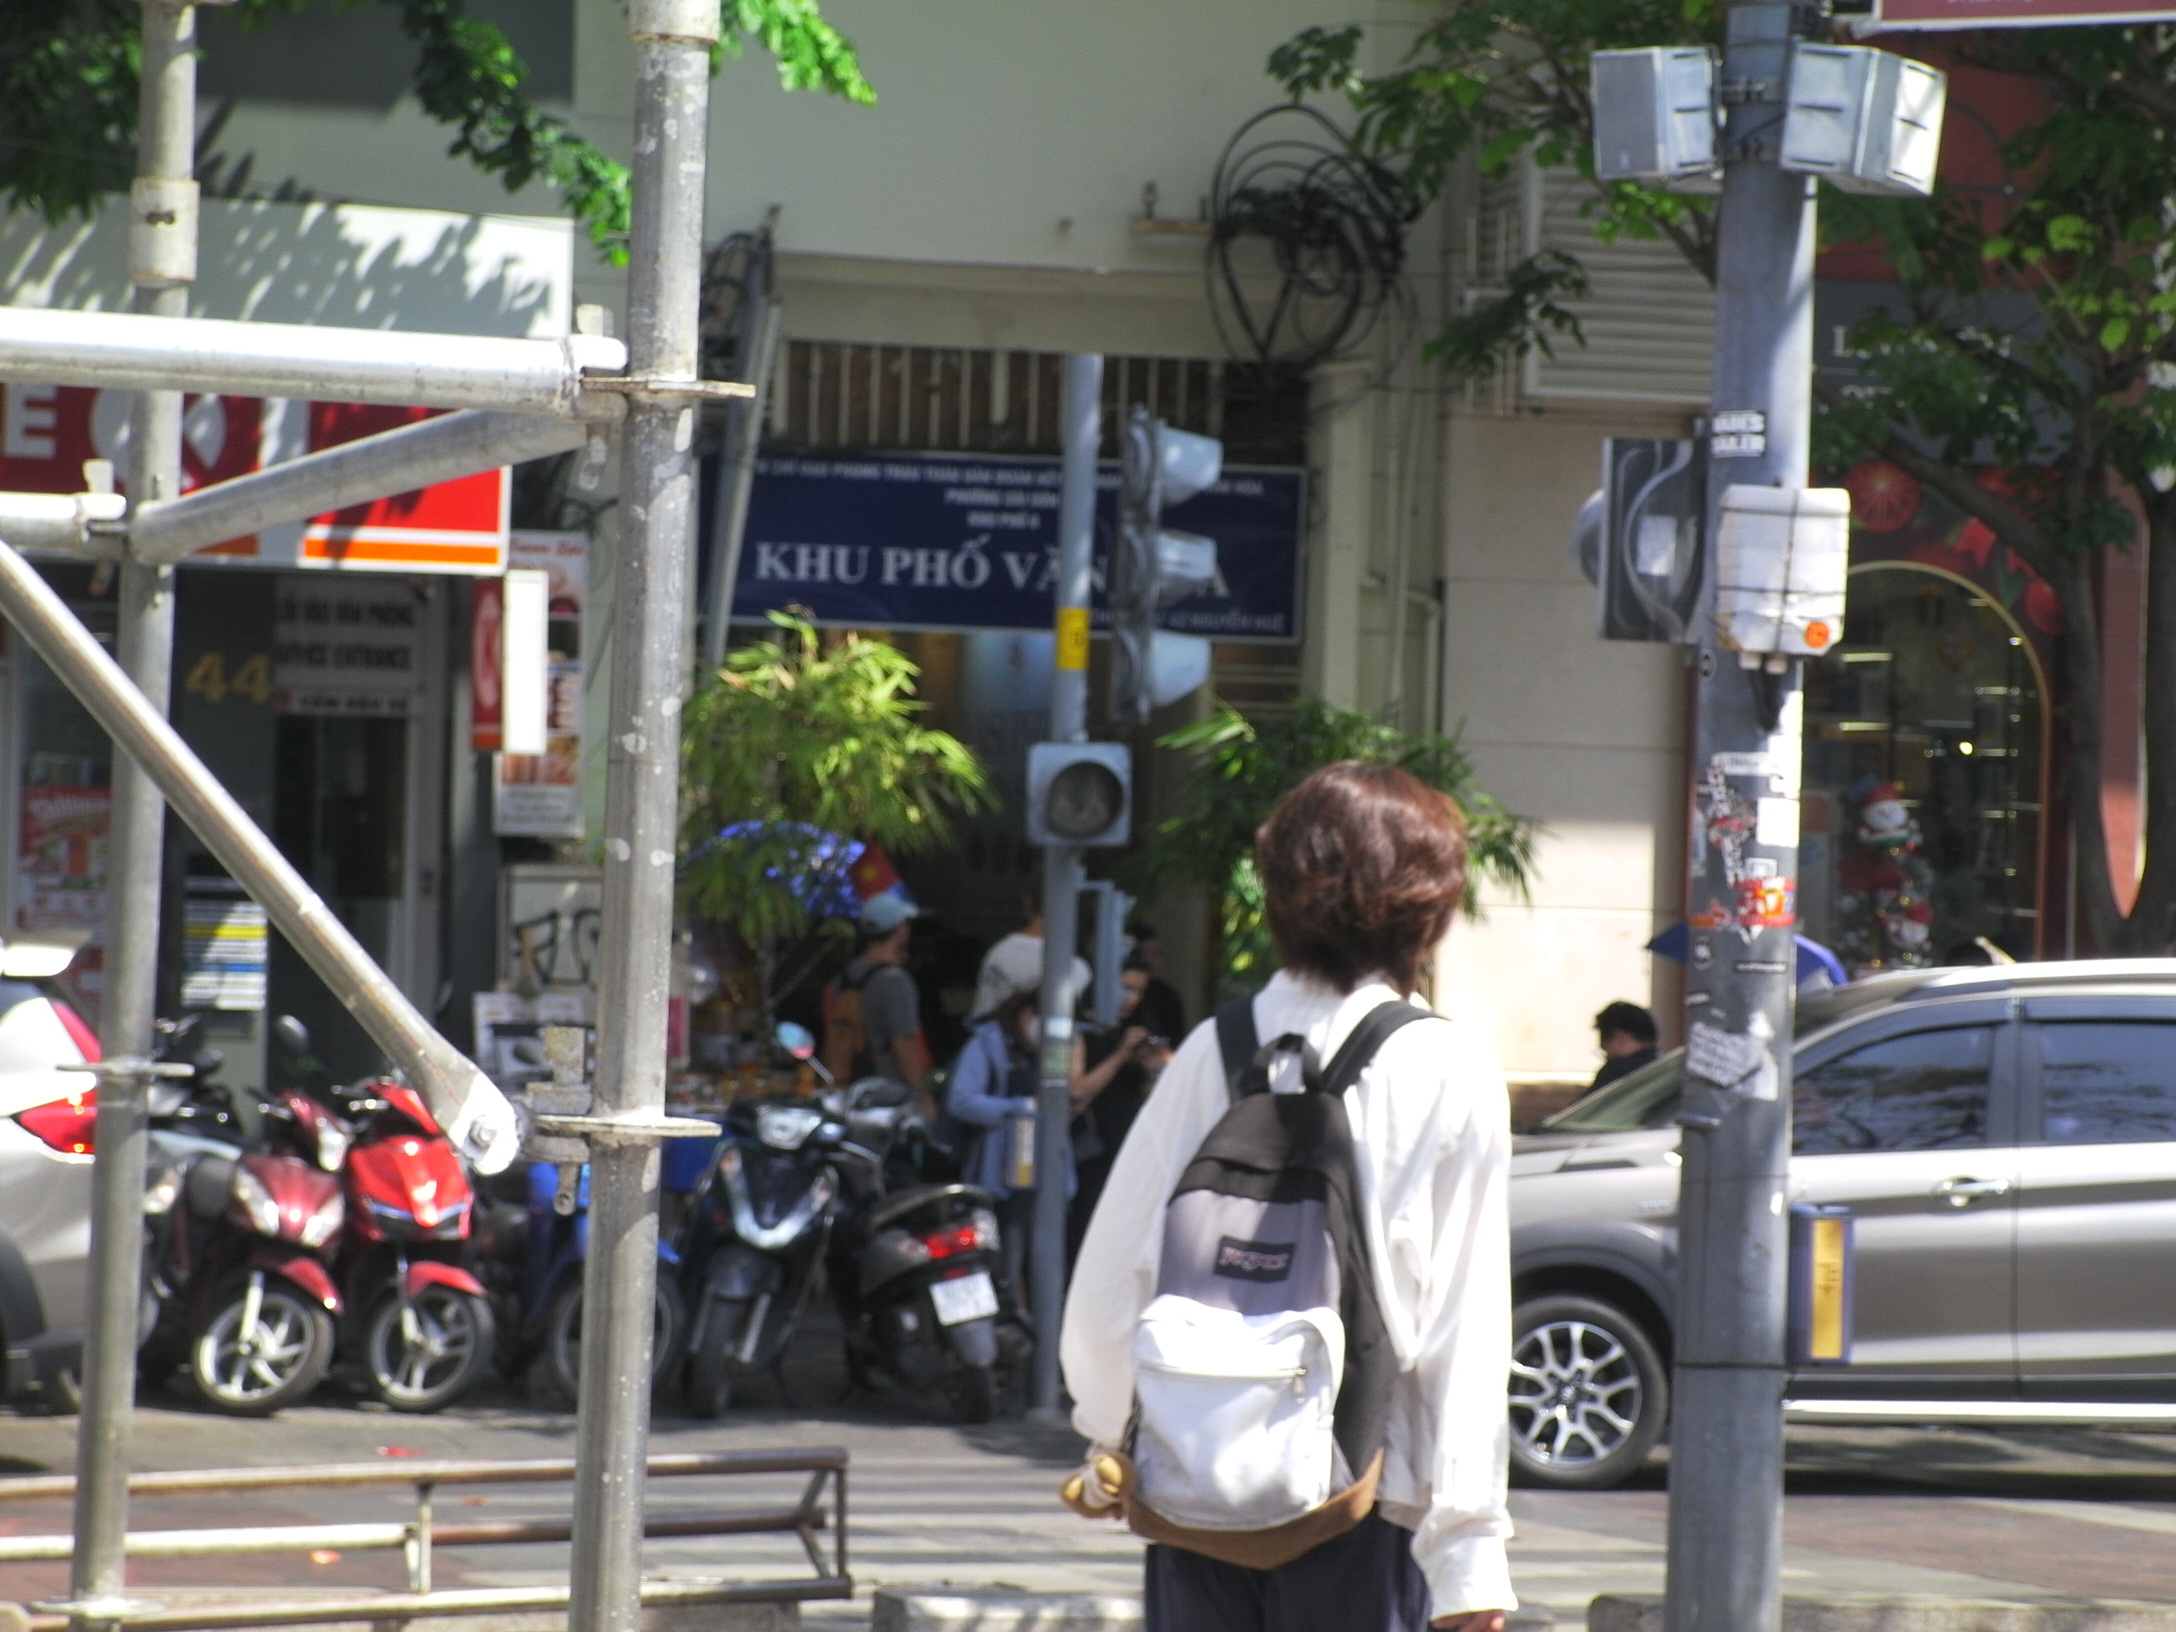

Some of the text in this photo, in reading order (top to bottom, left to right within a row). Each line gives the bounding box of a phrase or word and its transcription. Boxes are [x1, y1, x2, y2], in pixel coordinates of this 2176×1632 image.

[756, 543, 869, 583] KHU
[881, 533, 992, 590] PHỐ
[186, 651, 272, 704] 44
